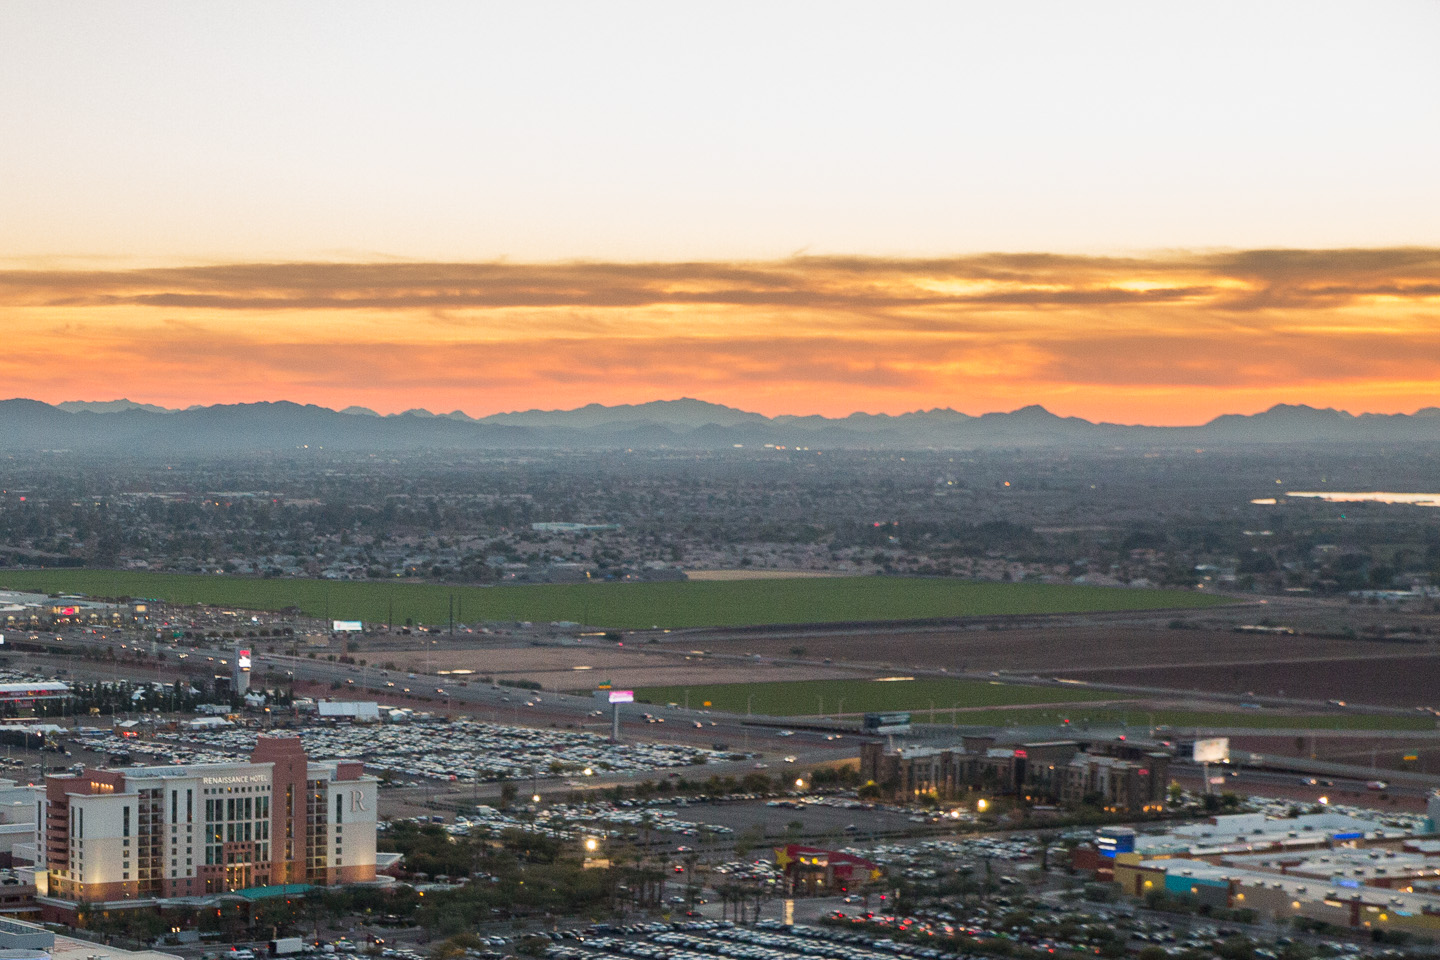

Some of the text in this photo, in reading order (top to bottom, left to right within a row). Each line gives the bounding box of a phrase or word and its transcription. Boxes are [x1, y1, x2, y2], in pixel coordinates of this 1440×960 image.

[202, 774, 268, 785] RENAISSANCE HOTEL
[349, 790, 370, 812] R
